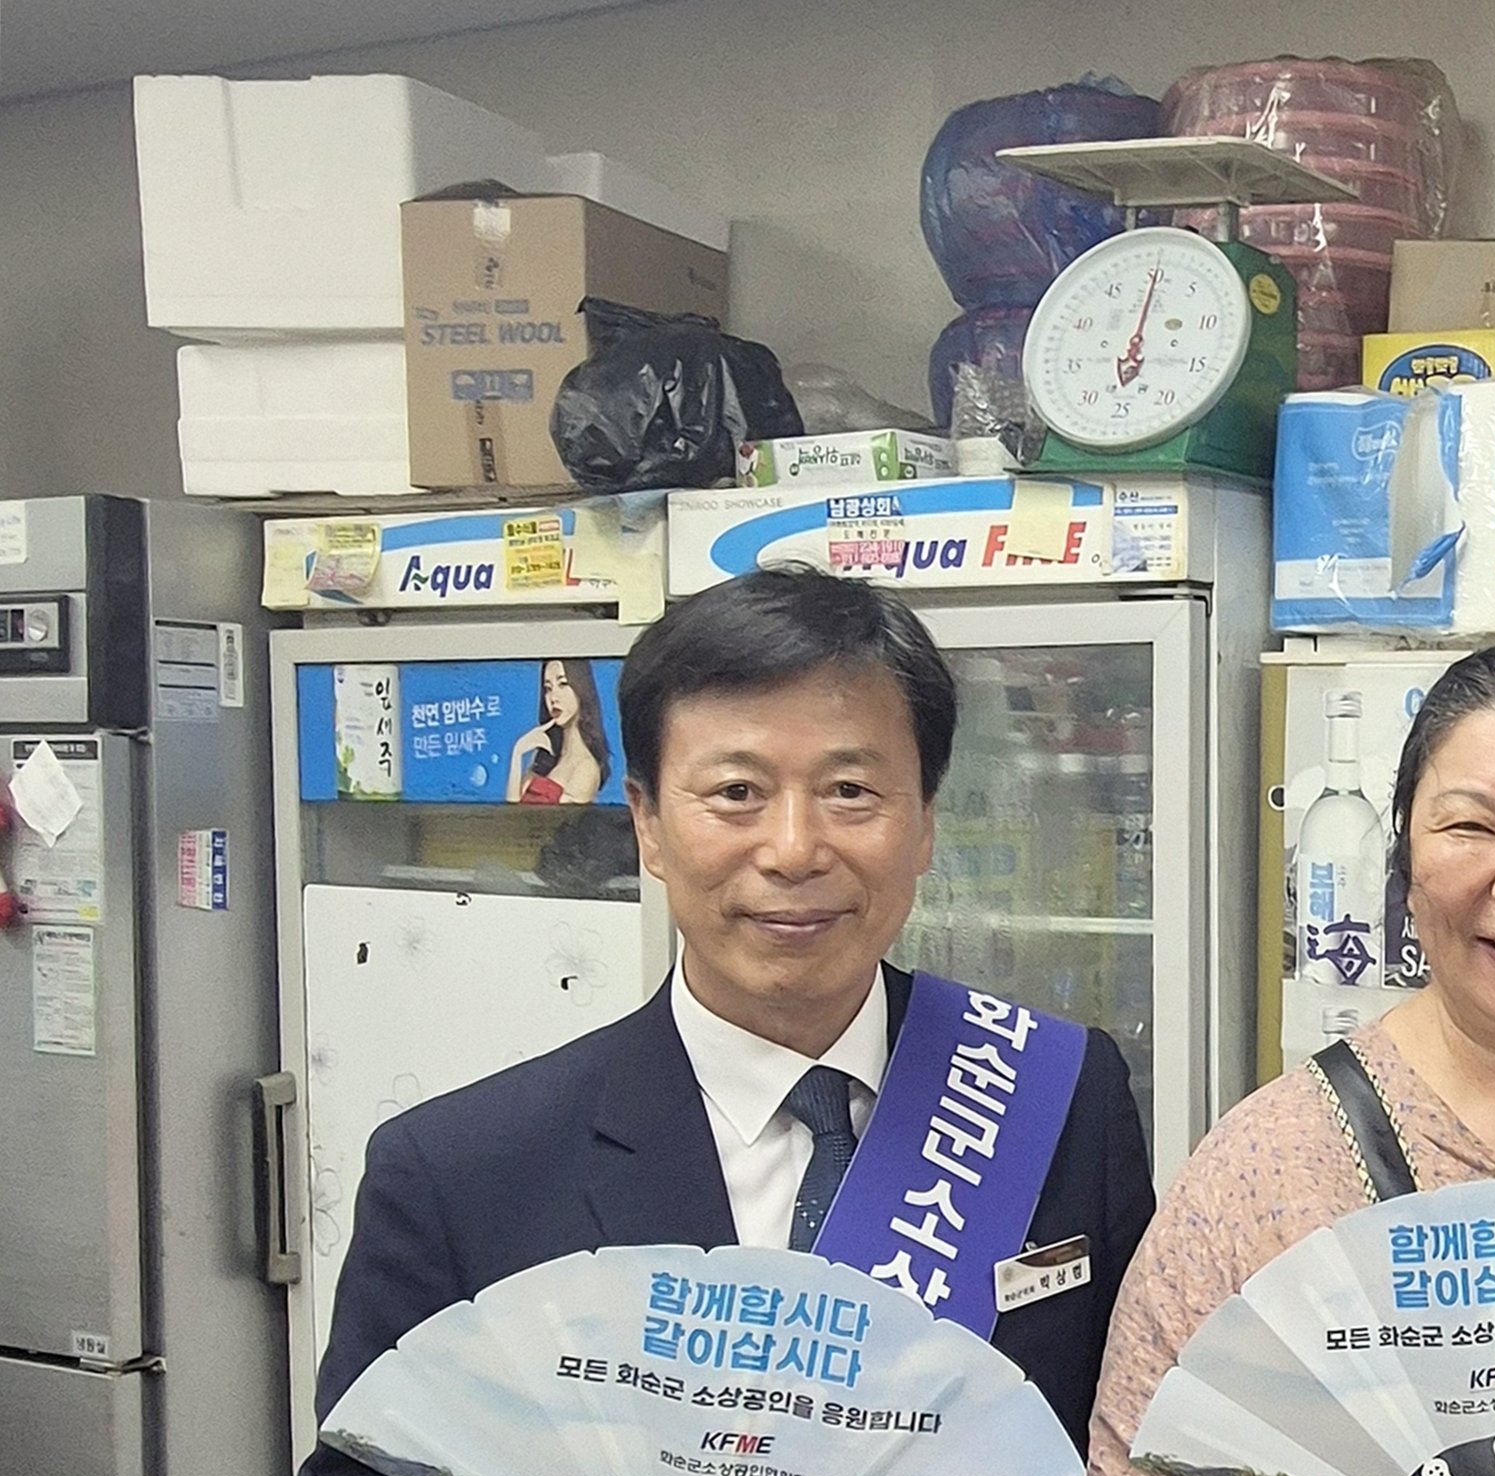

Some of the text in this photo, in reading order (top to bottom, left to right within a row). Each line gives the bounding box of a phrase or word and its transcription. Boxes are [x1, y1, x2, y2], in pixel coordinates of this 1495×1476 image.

[1104, 282, 1123, 300] 45
[1185, 281, 1197, 298] 5
[1072, 316, 1094, 333] 40
[1199, 314, 1217, 331] 10
[421, 322, 566, 346] STEEL WOOL
[1062, 357, 1082, 376] 35
[1188, 355, 1206, 374] 15
[1077, 390, 1099, 407] 30
[1153, 389, 1176, 407] 20
[1110, 402, 1132, 420] 25
[400, 554, 494, 598] Aqua
[411, 703, 440, 728] 천연
[412, 735, 442, 759] 만든
[647, 1270, 872, 1344] 함께합시다
[1326, 1327, 1372, 1351] 모든
[1378, 1326, 1444, 1348] 화순군
[641, 1315, 863, 1389] 같이삽시다
[555, 1354, 943, 1435] 모든 화순군 소상공인을 응원합니다
[699, 1431, 777, 1455] KFME
